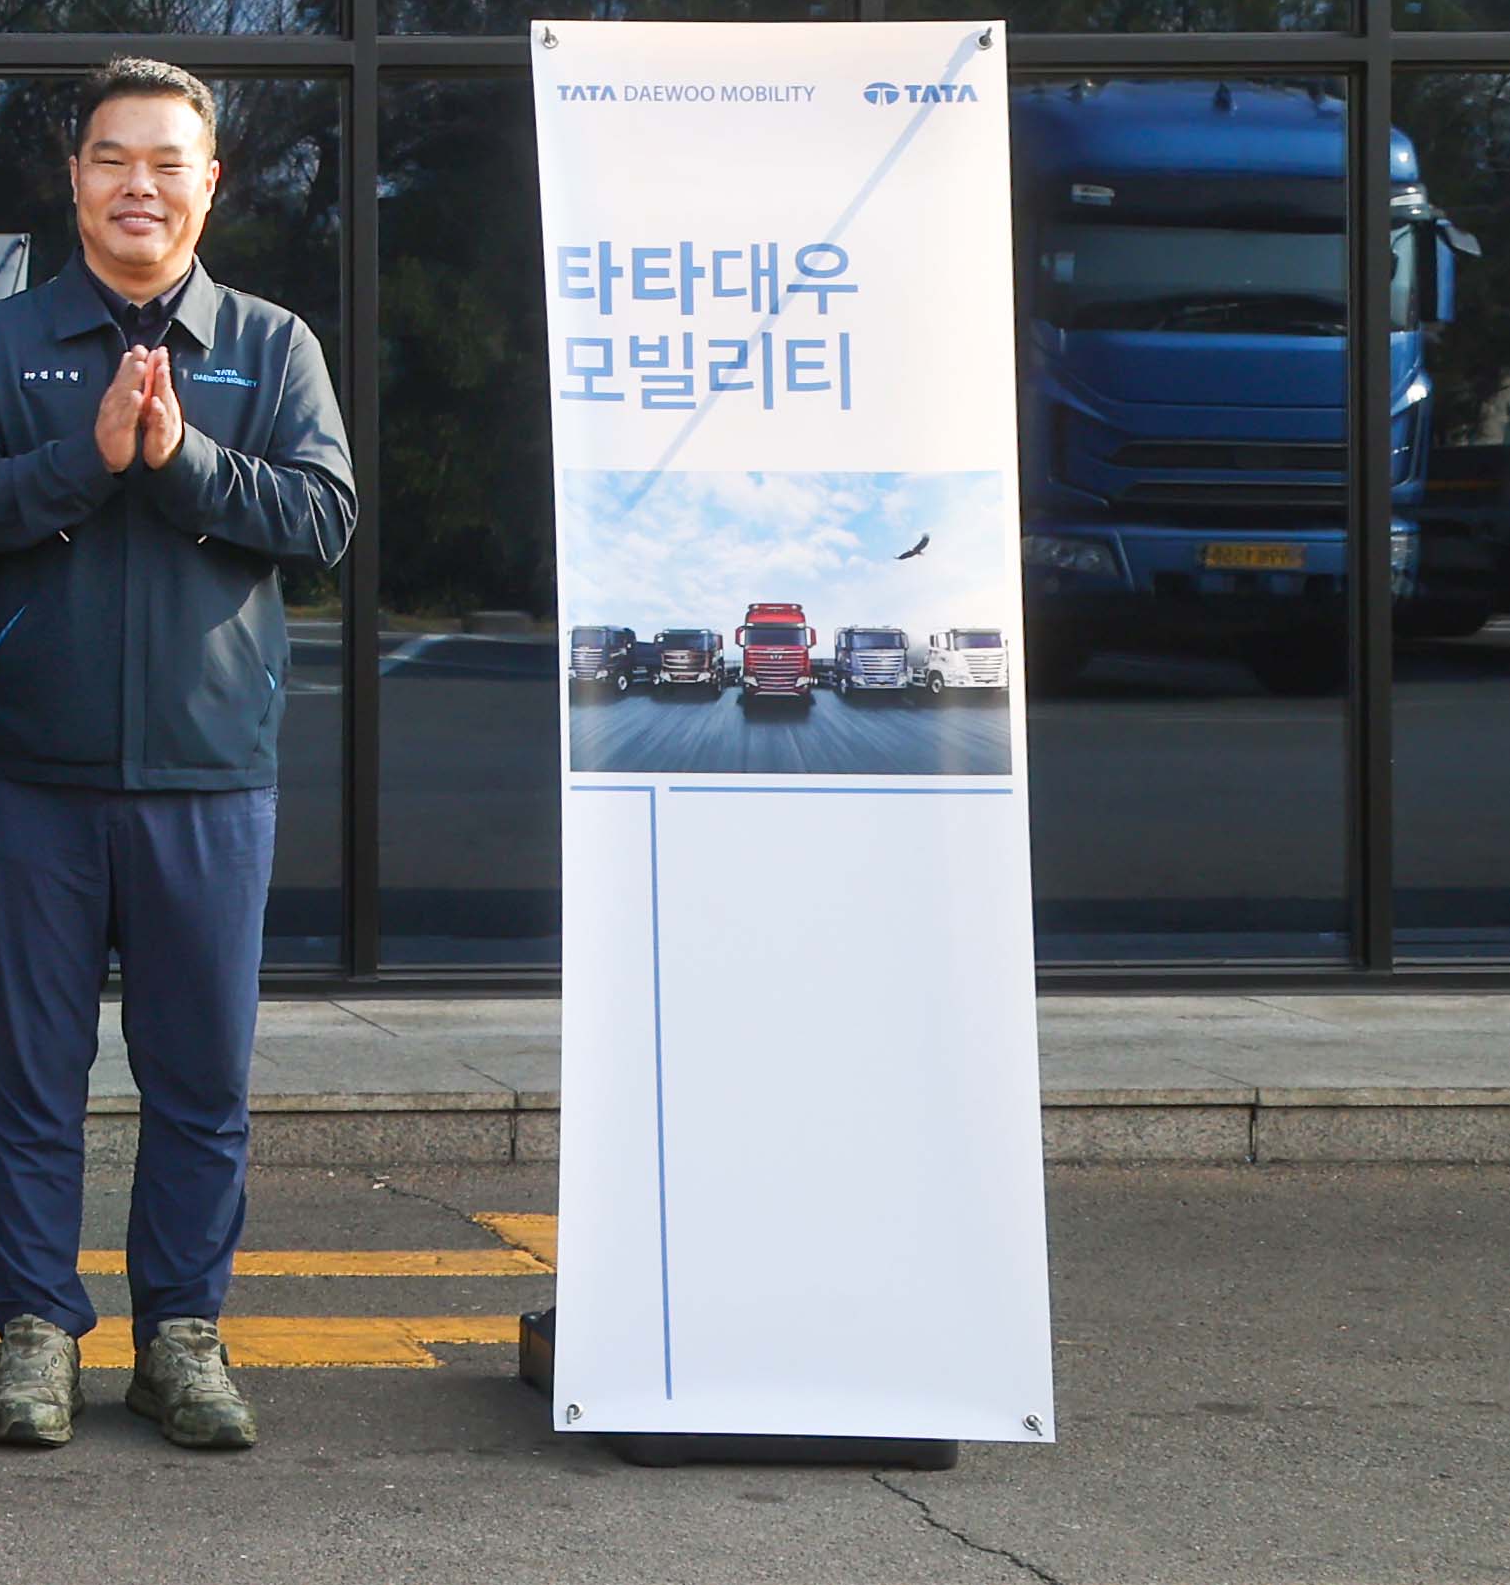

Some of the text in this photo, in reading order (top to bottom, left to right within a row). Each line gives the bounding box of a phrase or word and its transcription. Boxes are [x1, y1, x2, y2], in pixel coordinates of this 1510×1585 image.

[557, 85, 816, 103] TATA DAEWOO MOBILITY
[904, 83, 979, 104] TATA
[556, 240, 859, 316] 타타대우
[559, 331, 852, 411] 모빌리티
